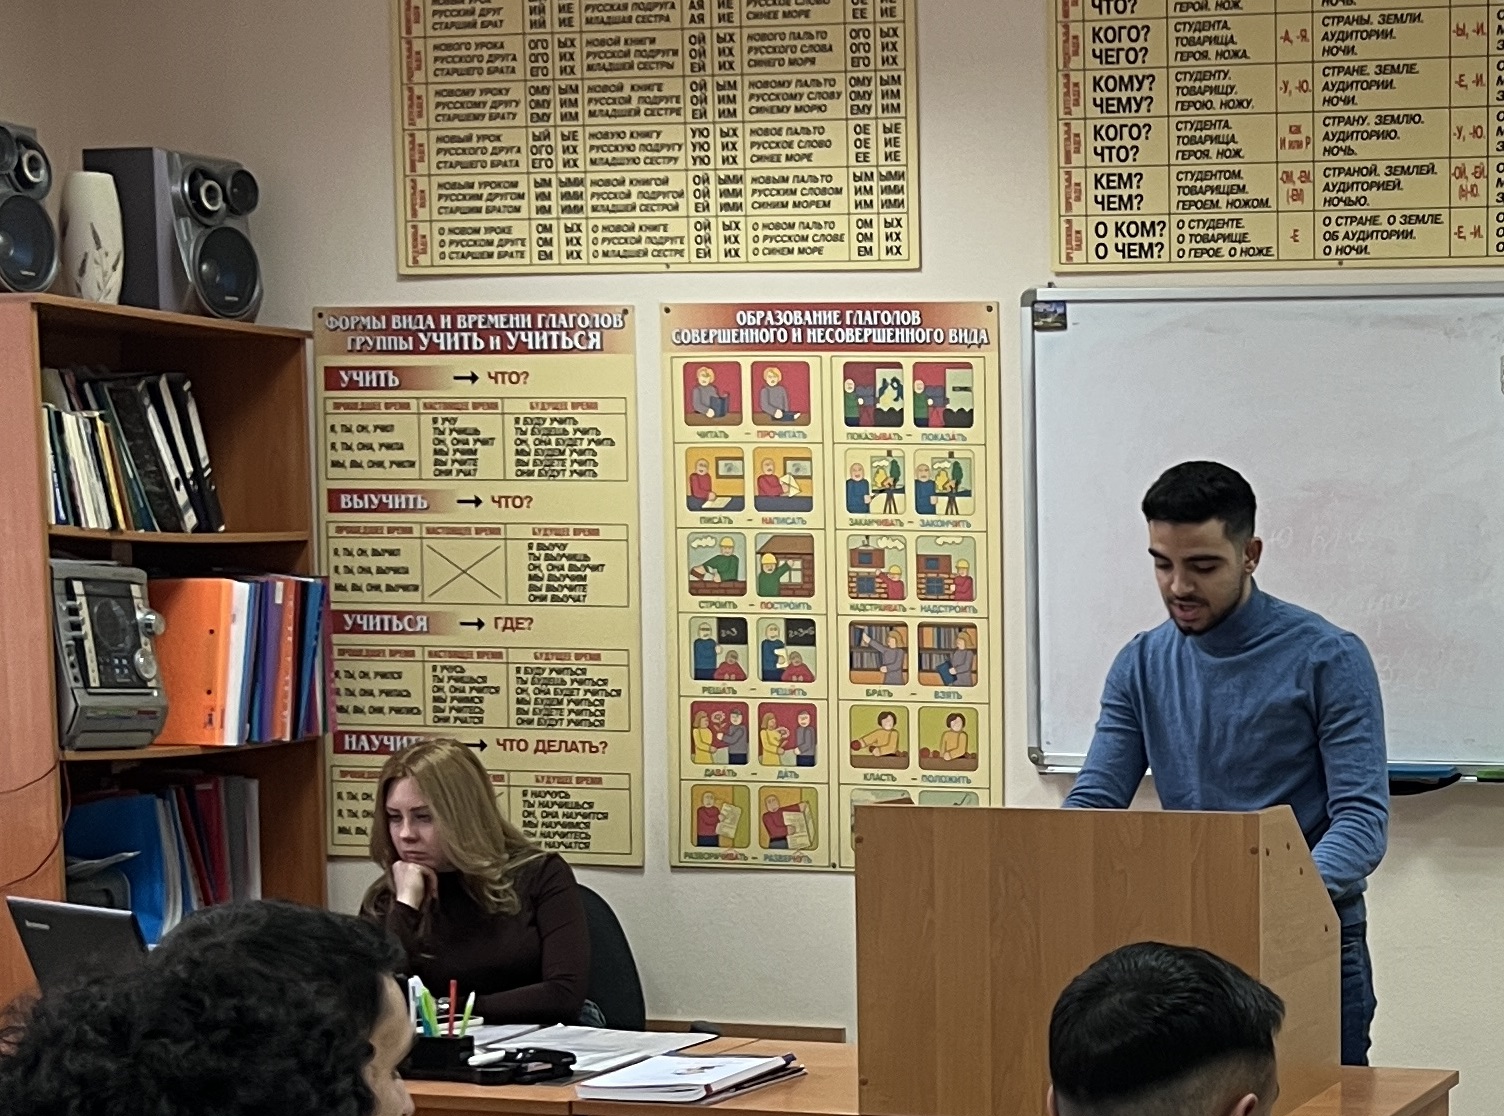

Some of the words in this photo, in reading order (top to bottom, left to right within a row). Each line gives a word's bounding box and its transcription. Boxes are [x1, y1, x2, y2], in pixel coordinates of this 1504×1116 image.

[1322, 15, 1373, 26] СТРАНЫ.
[1378, 12, 1424, 24] ЗЕМЛИ.
[1174, 21, 1231, 32] СТУДЕНТА.
[1092, 25, 1150, 43] КОГО?
[1322, 30, 1396, 41] АУДИТОРИИ.
[1175, 34, 1237, 47] ТОВАРИЩА.
[1092, 47, 1148, 65] ЧЕГО?
[1174, 51, 1211, 62] ГЕРОЯ.
[1215, 49, 1251, 60] НОЖА.
[1322, 46, 1358, 56] НОЧИ.
[1175, 70, 1232, 82] СТУДЕНТУ.
[1322, 66, 1370, 76] СТРАНЕ.
[1093, 75, 1155, 93] КОМУ?
[1322, 80, 1396, 92] АУДИТОРИИ.
[1175, 85, 1238, 96] ТОВАРИЩУ.
[1093, 97, 1153, 114] ЧЕМУ?
[1175, 100, 1215, 112] ГЕРОЮ.
[1220, 98, 1254, 110] НОЖУ.
[1322, 97, 1358, 107] НОЧИ.
[1176, 120, 1232, 132] СТУДЕНТА.
[1322, 116, 1370, 127] СТРАНУ.
[1374, 114, 1424, 125] ЗЕМЛЮ.
[1094, 124, 1152, 141] КОГО?
[1322, 130, 1400, 142] АУДИТОРИЮ.
[1176, 135, 1238, 146] ТОВАРИЩА.
[1094, 146, 1140, 163] ЧТО?
[1176, 150, 1212, 160] ГЕРОЯ.
[1216, 149, 1244, 159] НОЖ.
[1322, 146, 1357, 156] НОЧЬ.
[1176, 170, 1244, 182] СТУДЕНТОМ.
[1323, 165, 1380, 178] СТРАНОЙ.
[1384, 163, 1438, 176] ЗЕМЛЕЙ.
[1094, 173, 1144, 190] КЕМ?
[1322, 180, 1403, 192] АУДИТОРИЕЙ.
[1176, 184, 1249, 196] ТОВАРИЩЕМ.
[1094, 194, 1144, 211] ЧЕМ?
[1176, 200, 1222, 210] ГЕРОЕМ.
[1226, 198, 1272, 208] НОЖОМ.
[1323, 196, 1370, 207] НОЧЬЮ.
[856, 219, 873, 229] ОМ
[884, 218, 902, 228] ЫХ
[1323, 217, 1331, 227] О
[1336, 216, 1382, 226] СТРАНЕ.
[1387, 215, 1396, 226] О
[1095, 221, 1107, 238] О
[1115, 220, 1166, 238] КОМ?
[856, 233, 873, 243] ОМ
[886, 232, 902, 242] ИХ
[1323, 231, 1339, 241] ОБ
[1342, 230, 1416, 242] АУДИТОРИИ.
[858, 246, 873, 256] ЕМ
[886, 246, 902, 256] ИХ
[1095, 243, 1107, 259] О
[1115, 242, 1164, 259] ЧЕМ?
[1323, 246, 1331, 256] О
[1336, 245, 1370, 255] НОЧИ.
[1496, 241, 1504, 252] О
[326, 315, 386, 331] ФОРМЫ
[392, 315, 435, 330] ВИДА
[440, 315, 451, 329] И
[457, 315, 532, 329] ВРЕМЕНИ
[538, 314, 624, 330] ГЛАГОЛОВ
[736, 311, 841, 326] ОБРАЗОВАНИЕ
[846, 311, 921, 326] ГЛАГОЛОВ
[347, 335, 414, 352] ГРУППЫ
[418, 333, 484, 351] УЧИТЬ
[506, 331, 603, 350] УЧИТЬСЯ
[672, 329, 789, 344] СОВЕРШЕННОГО
[792, 329, 802, 343] И
[807, 328, 943, 344] НЕСОВЕРШЕННОГО
[949, 329, 989, 347] ВИДА
[339, 370, 399, 388] УЧИТЬ
[488, 371, 529, 385] ЧТО?
[341, 494, 428, 509] ВЫУЧИТЬ
[491, 495, 533, 508] ЧТО?
[344, 615, 428, 632] УЧИТЬСЯ
[495, 617, 534, 631] ГДЕ?
[496, 739, 528, 751] ЧТО
[534, 739, 607, 754] ДЕЛАТЬ?
